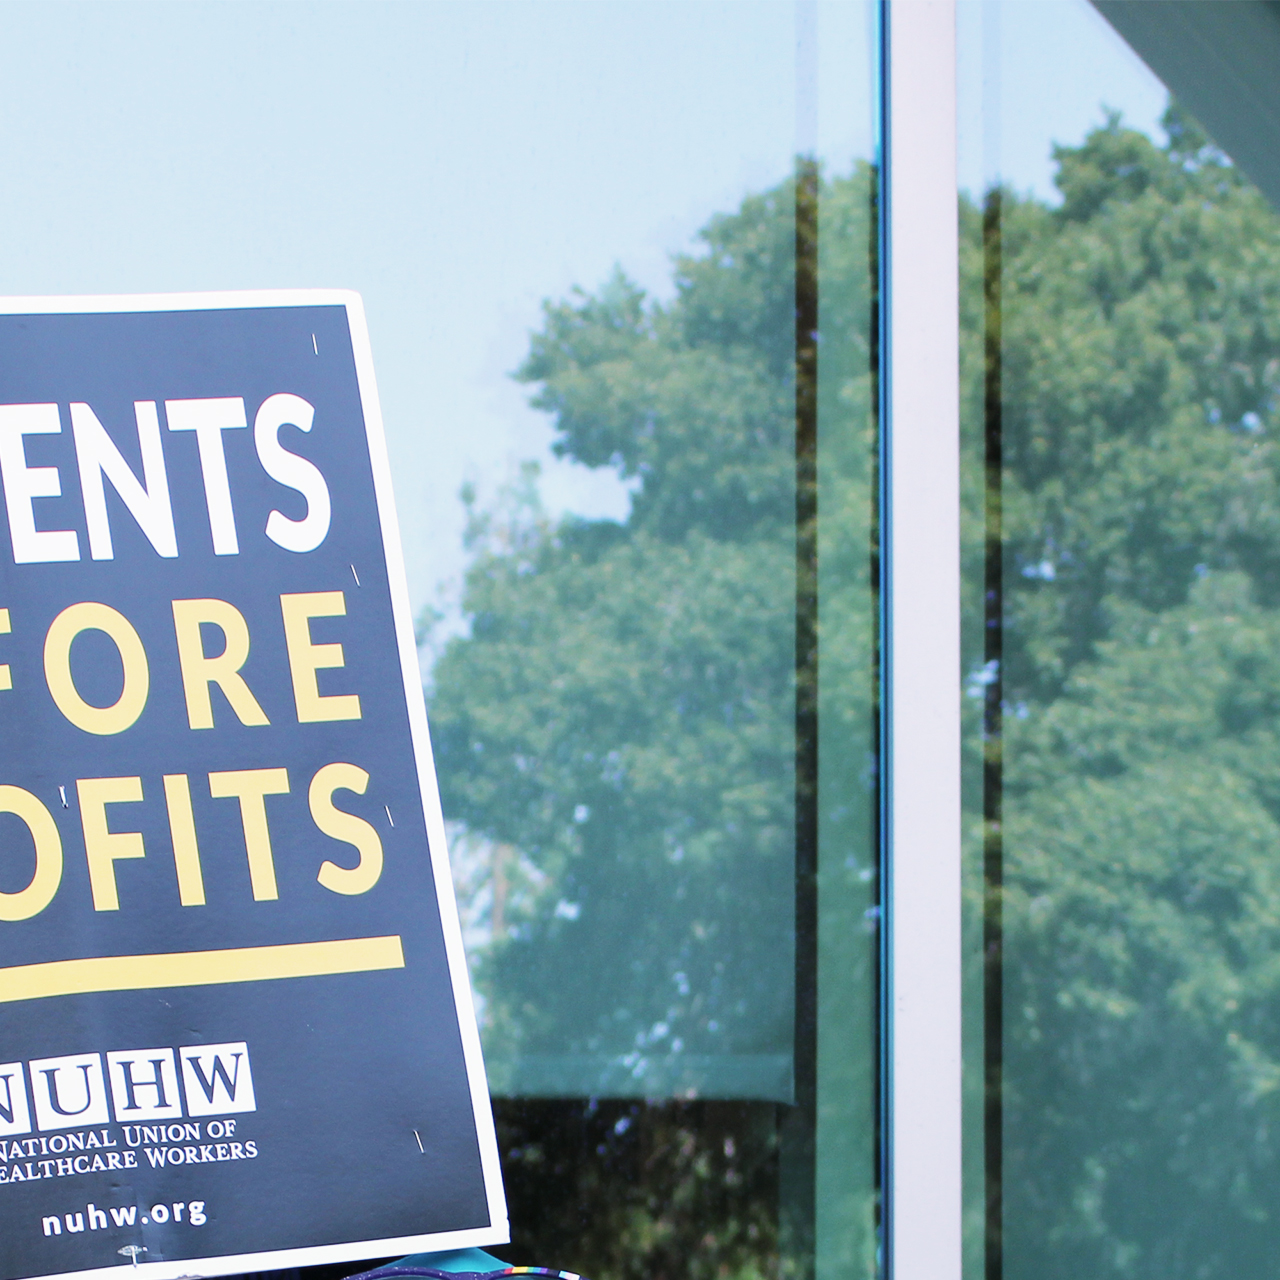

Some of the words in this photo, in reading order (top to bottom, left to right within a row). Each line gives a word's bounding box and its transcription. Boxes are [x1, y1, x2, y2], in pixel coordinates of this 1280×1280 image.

[122, 1123, 201, 1147] UNION
[207, 1119, 237, 1139] OF
[144, 1140, 258, 1169] WORKERS
[42, 1200, 207, 1237] nuhw.org
